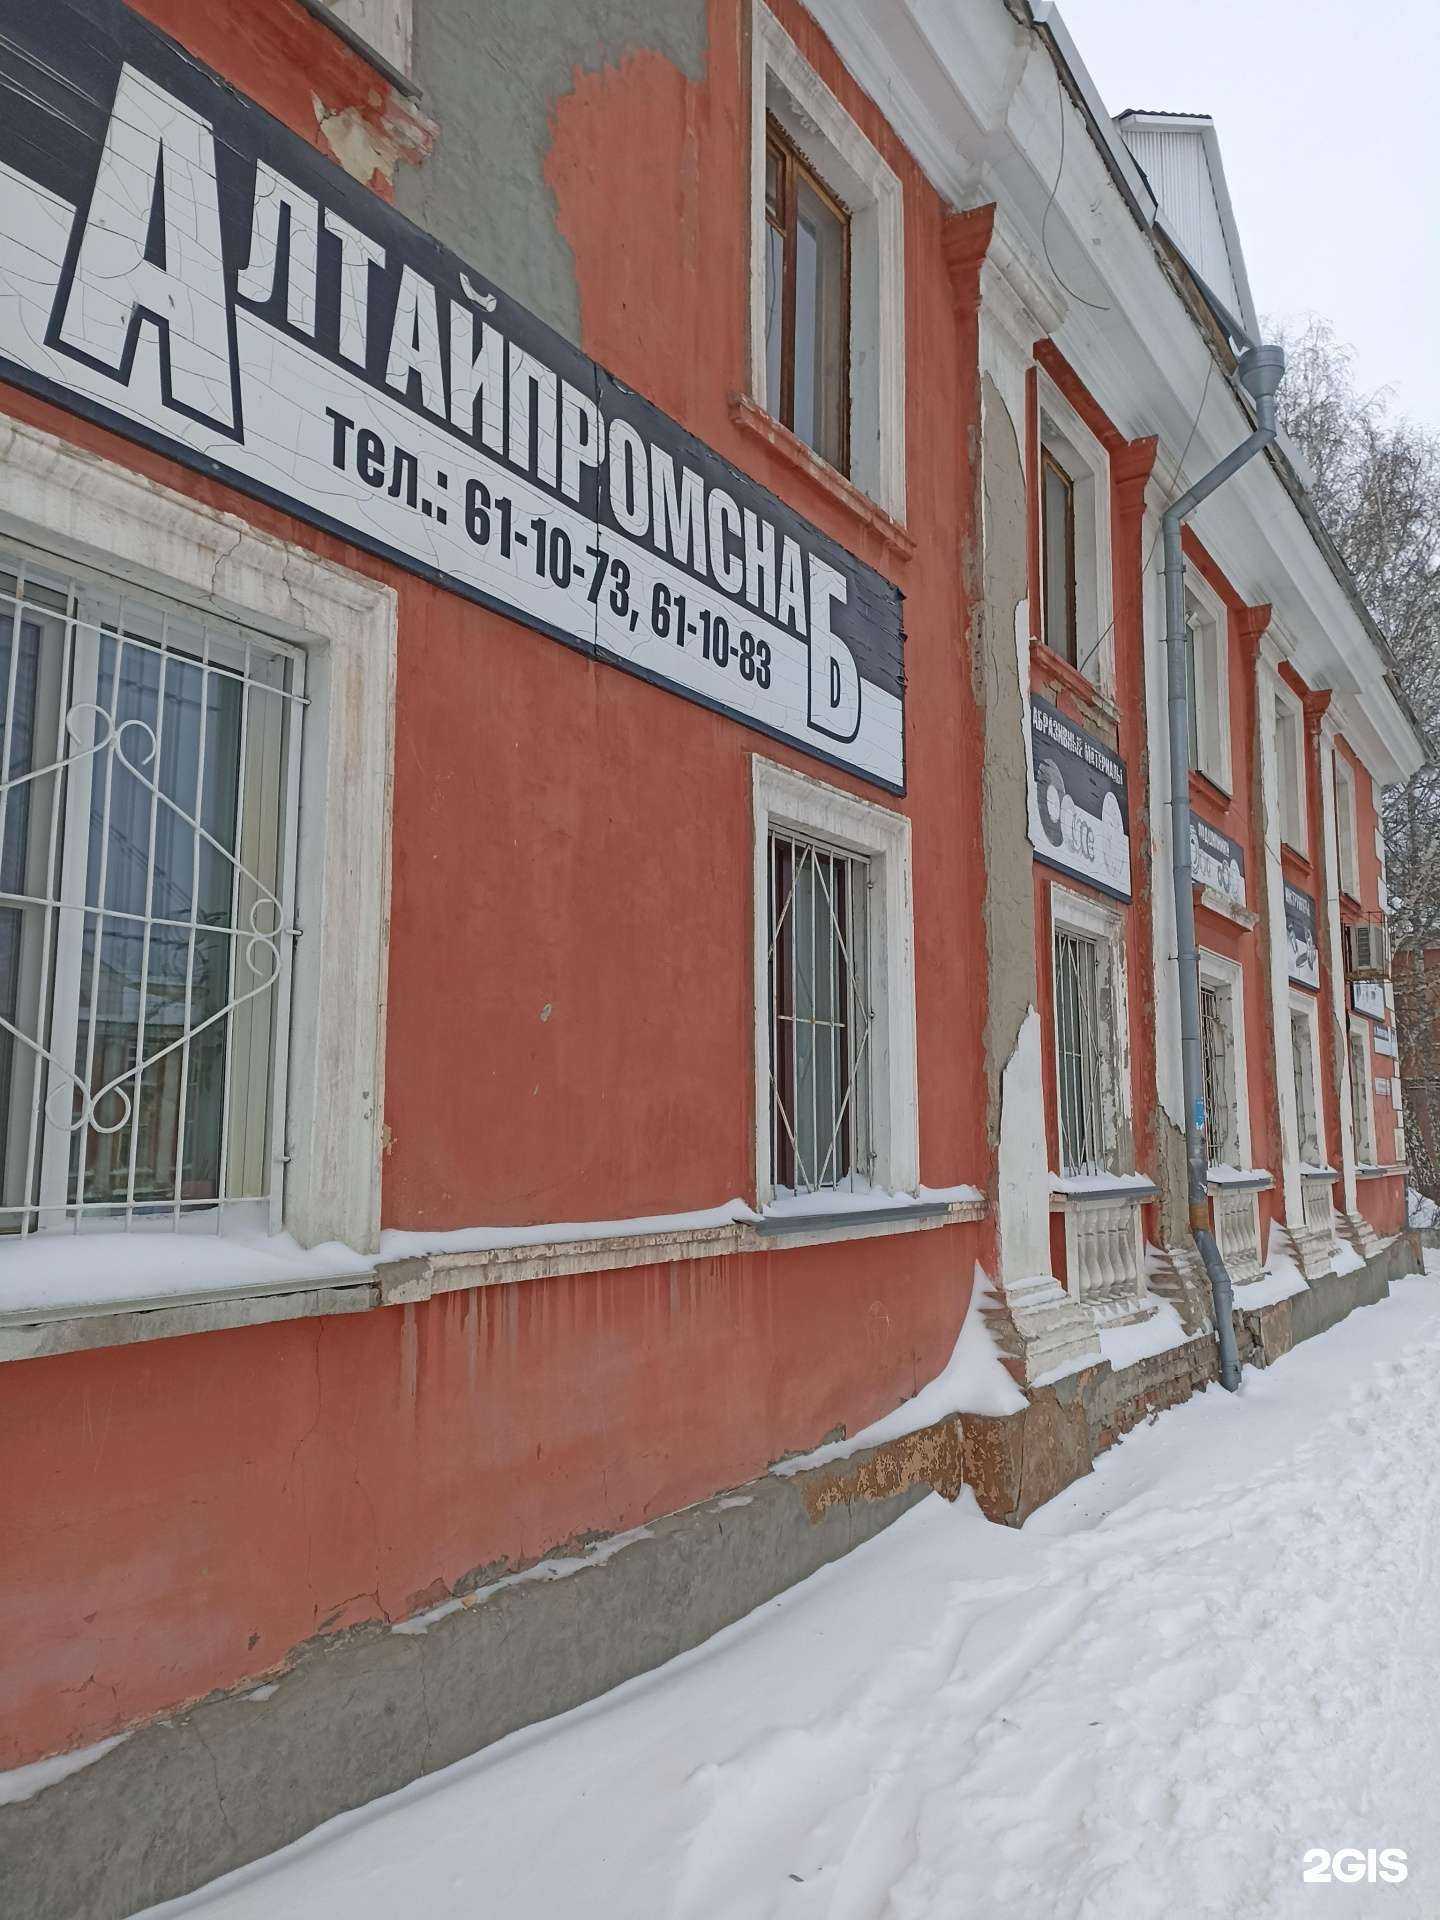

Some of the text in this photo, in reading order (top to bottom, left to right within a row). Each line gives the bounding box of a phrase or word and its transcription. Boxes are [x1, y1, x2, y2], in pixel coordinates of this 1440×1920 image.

[46, 62, 861, 743] АЛТАЙПРОМСНАБ
[326, 406, 772, 690] тел.: 61-10-73, 61-10-83
[1032, 706, 1083, 758] АБРАЗИВНЫЕ
